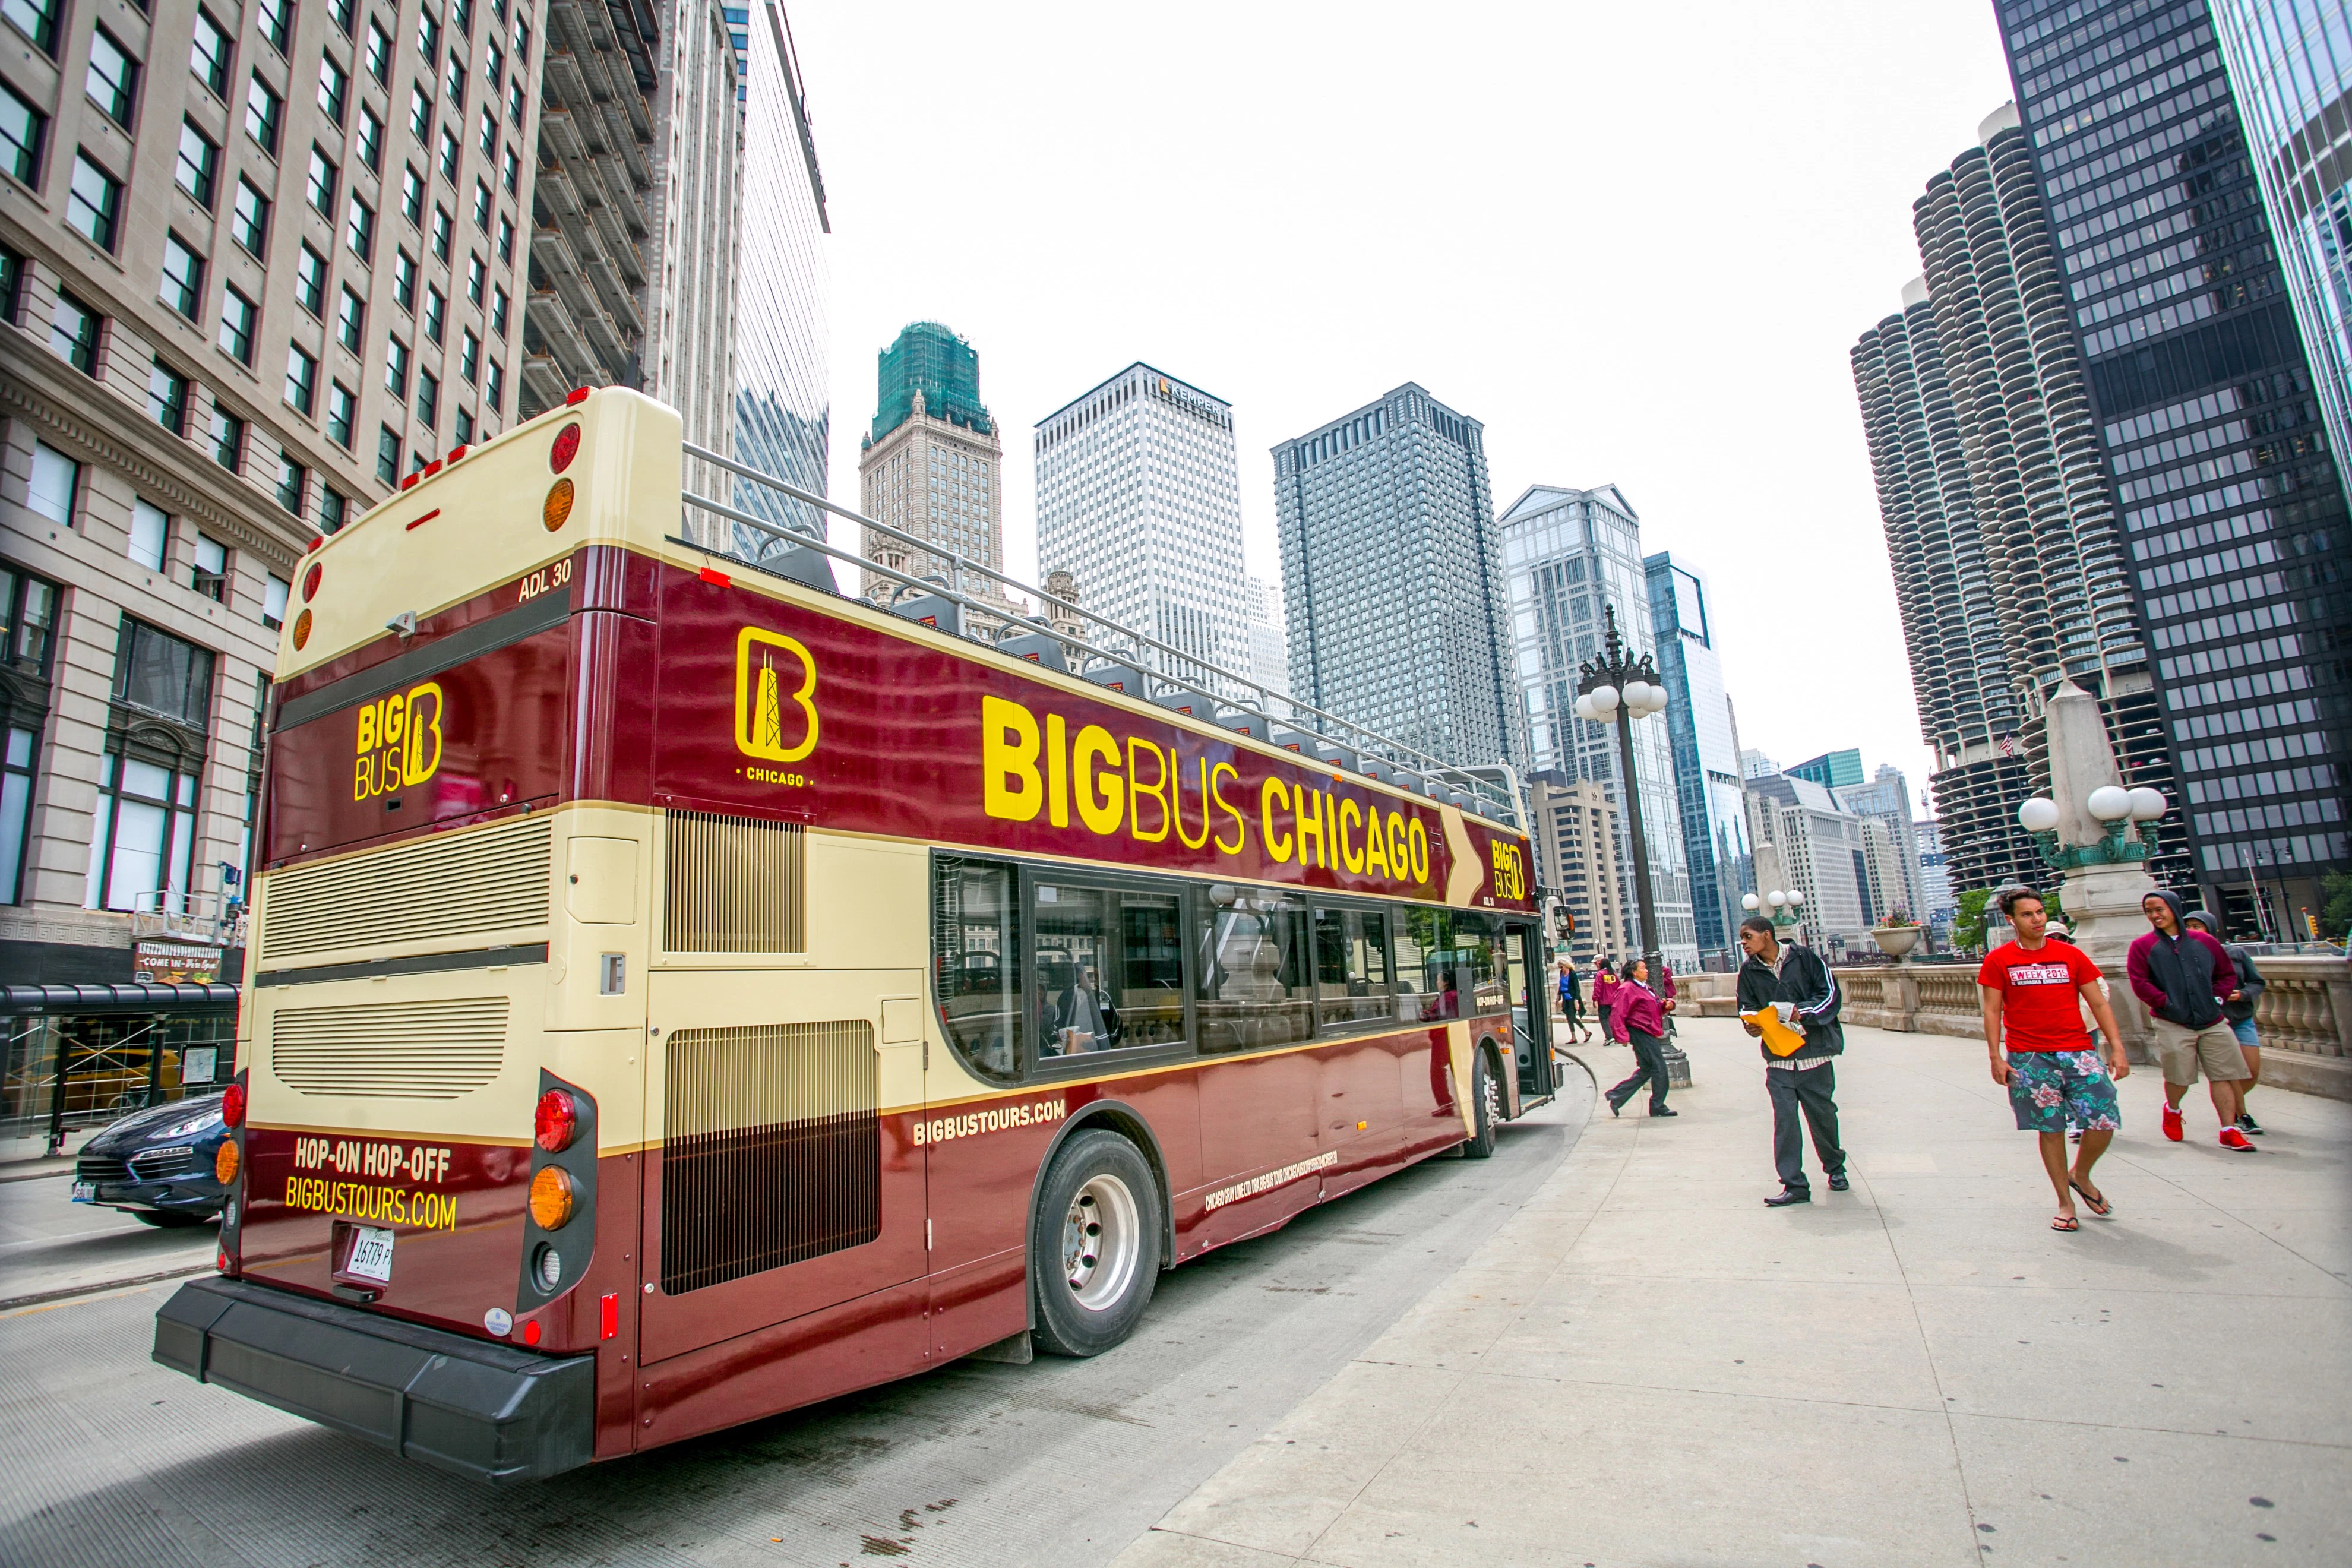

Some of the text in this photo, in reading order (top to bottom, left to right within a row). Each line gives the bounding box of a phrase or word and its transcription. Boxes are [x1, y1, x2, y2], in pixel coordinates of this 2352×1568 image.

[1171, 383, 1219, 415] KEMPER
[519, 559, 571, 602] ADL 30
[357, 694, 404, 754] BIG
[355, 747, 400, 801] BUS
[747, 767, 804, 786] CHICAGO
[1262, 776, 1429, 884] CHICAGO
[1491, 839, 1510, 871] BIG
[1494, 871, 1513, 899] BUS
[1490, 897, 1494, 906] 30
[144, 957, 169, 967] COME
[2011, 969, 2068, 980] EWEEK 2015
[1477, 995, 1504, 1006] HOP-ON HOP-OFF
[913, 1099, 1065, 1146] BIGBUSTOURS.COM
[295, 1137, 451, 1183] HOP-ON HOP-OFF
[285, 1176, 456, 1231] BIGBUSTOURS.COM
[1206, 1190, 1224, 1212] CHICAGO
[1224, 1186, 1235, 1205] GRAY
[1235, 1183, 1244, 1200] LINE
[1251, 1177, 1260, 1194] DBA
[1266, 1172, 1274, 1188] BUS
[1273, 1169, 1284, 1186] TOUR
[354, 1240, 384, 1266] 16779
